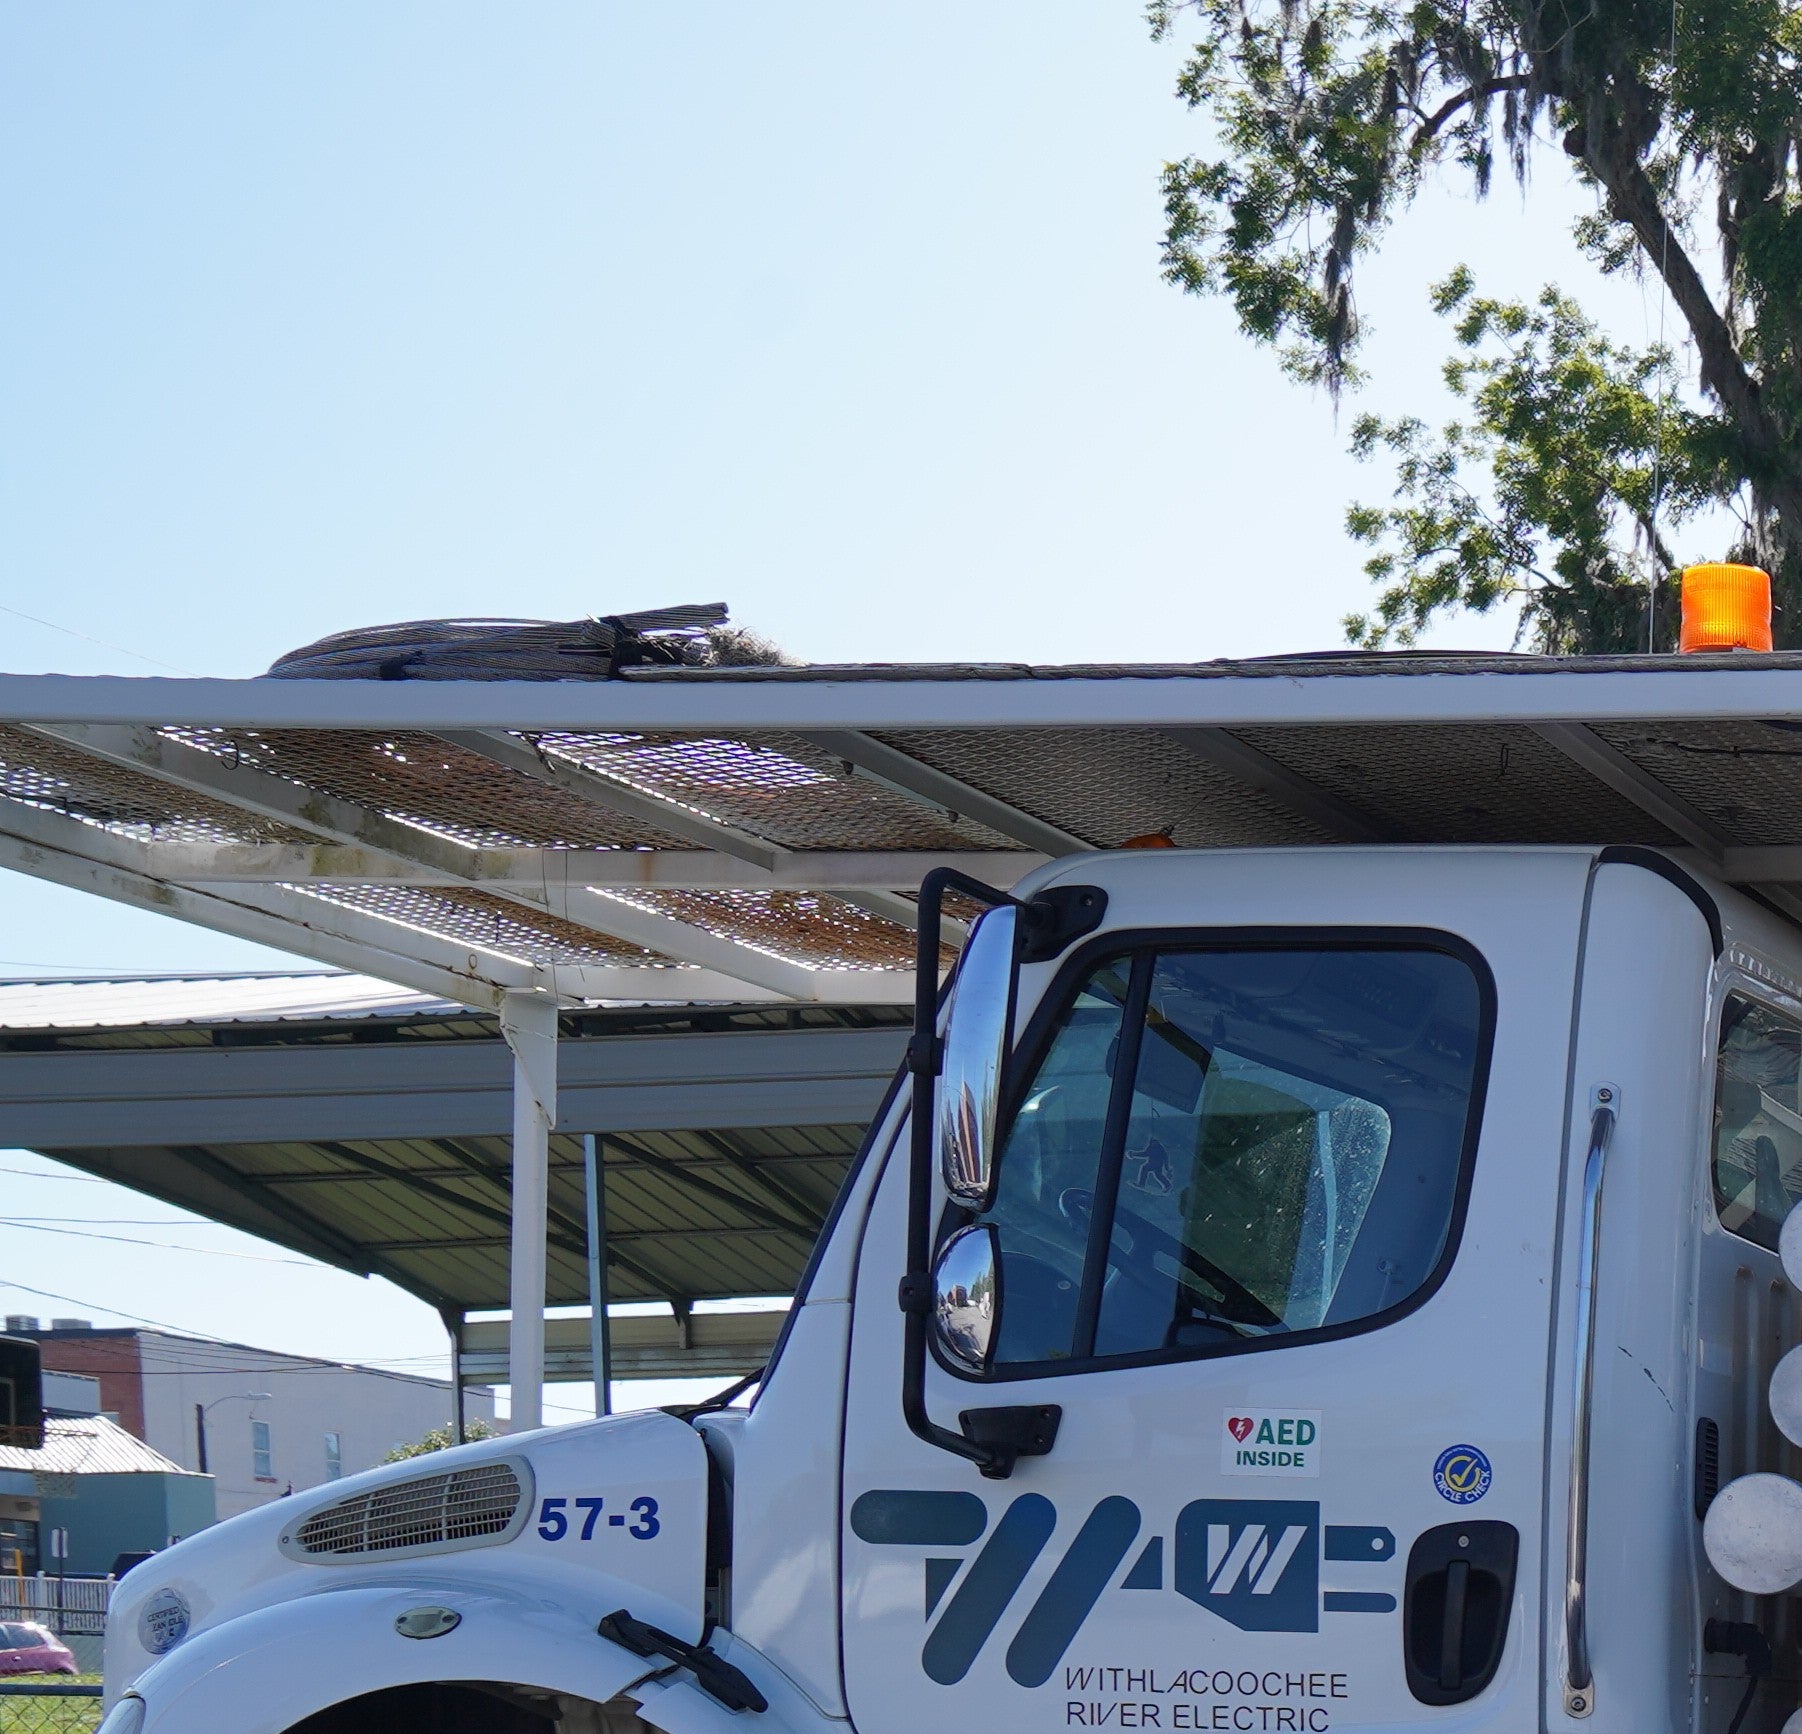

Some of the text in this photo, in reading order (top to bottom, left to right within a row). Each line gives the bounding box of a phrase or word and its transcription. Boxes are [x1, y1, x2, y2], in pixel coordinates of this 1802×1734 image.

[1255, 1418, 1316, 1445] AED
[1236, 1450, 1304, 1467] INSIDE
[1435, 1470, 1491, 1502] CIRCLE CHECK
[538, 1496, 660, 1541] 57-3
[1066, 1666, 1349, 1698] WITHLACOOCHEE
[1067, 1701, 1329, 1732] RIVER ELECTRIC
